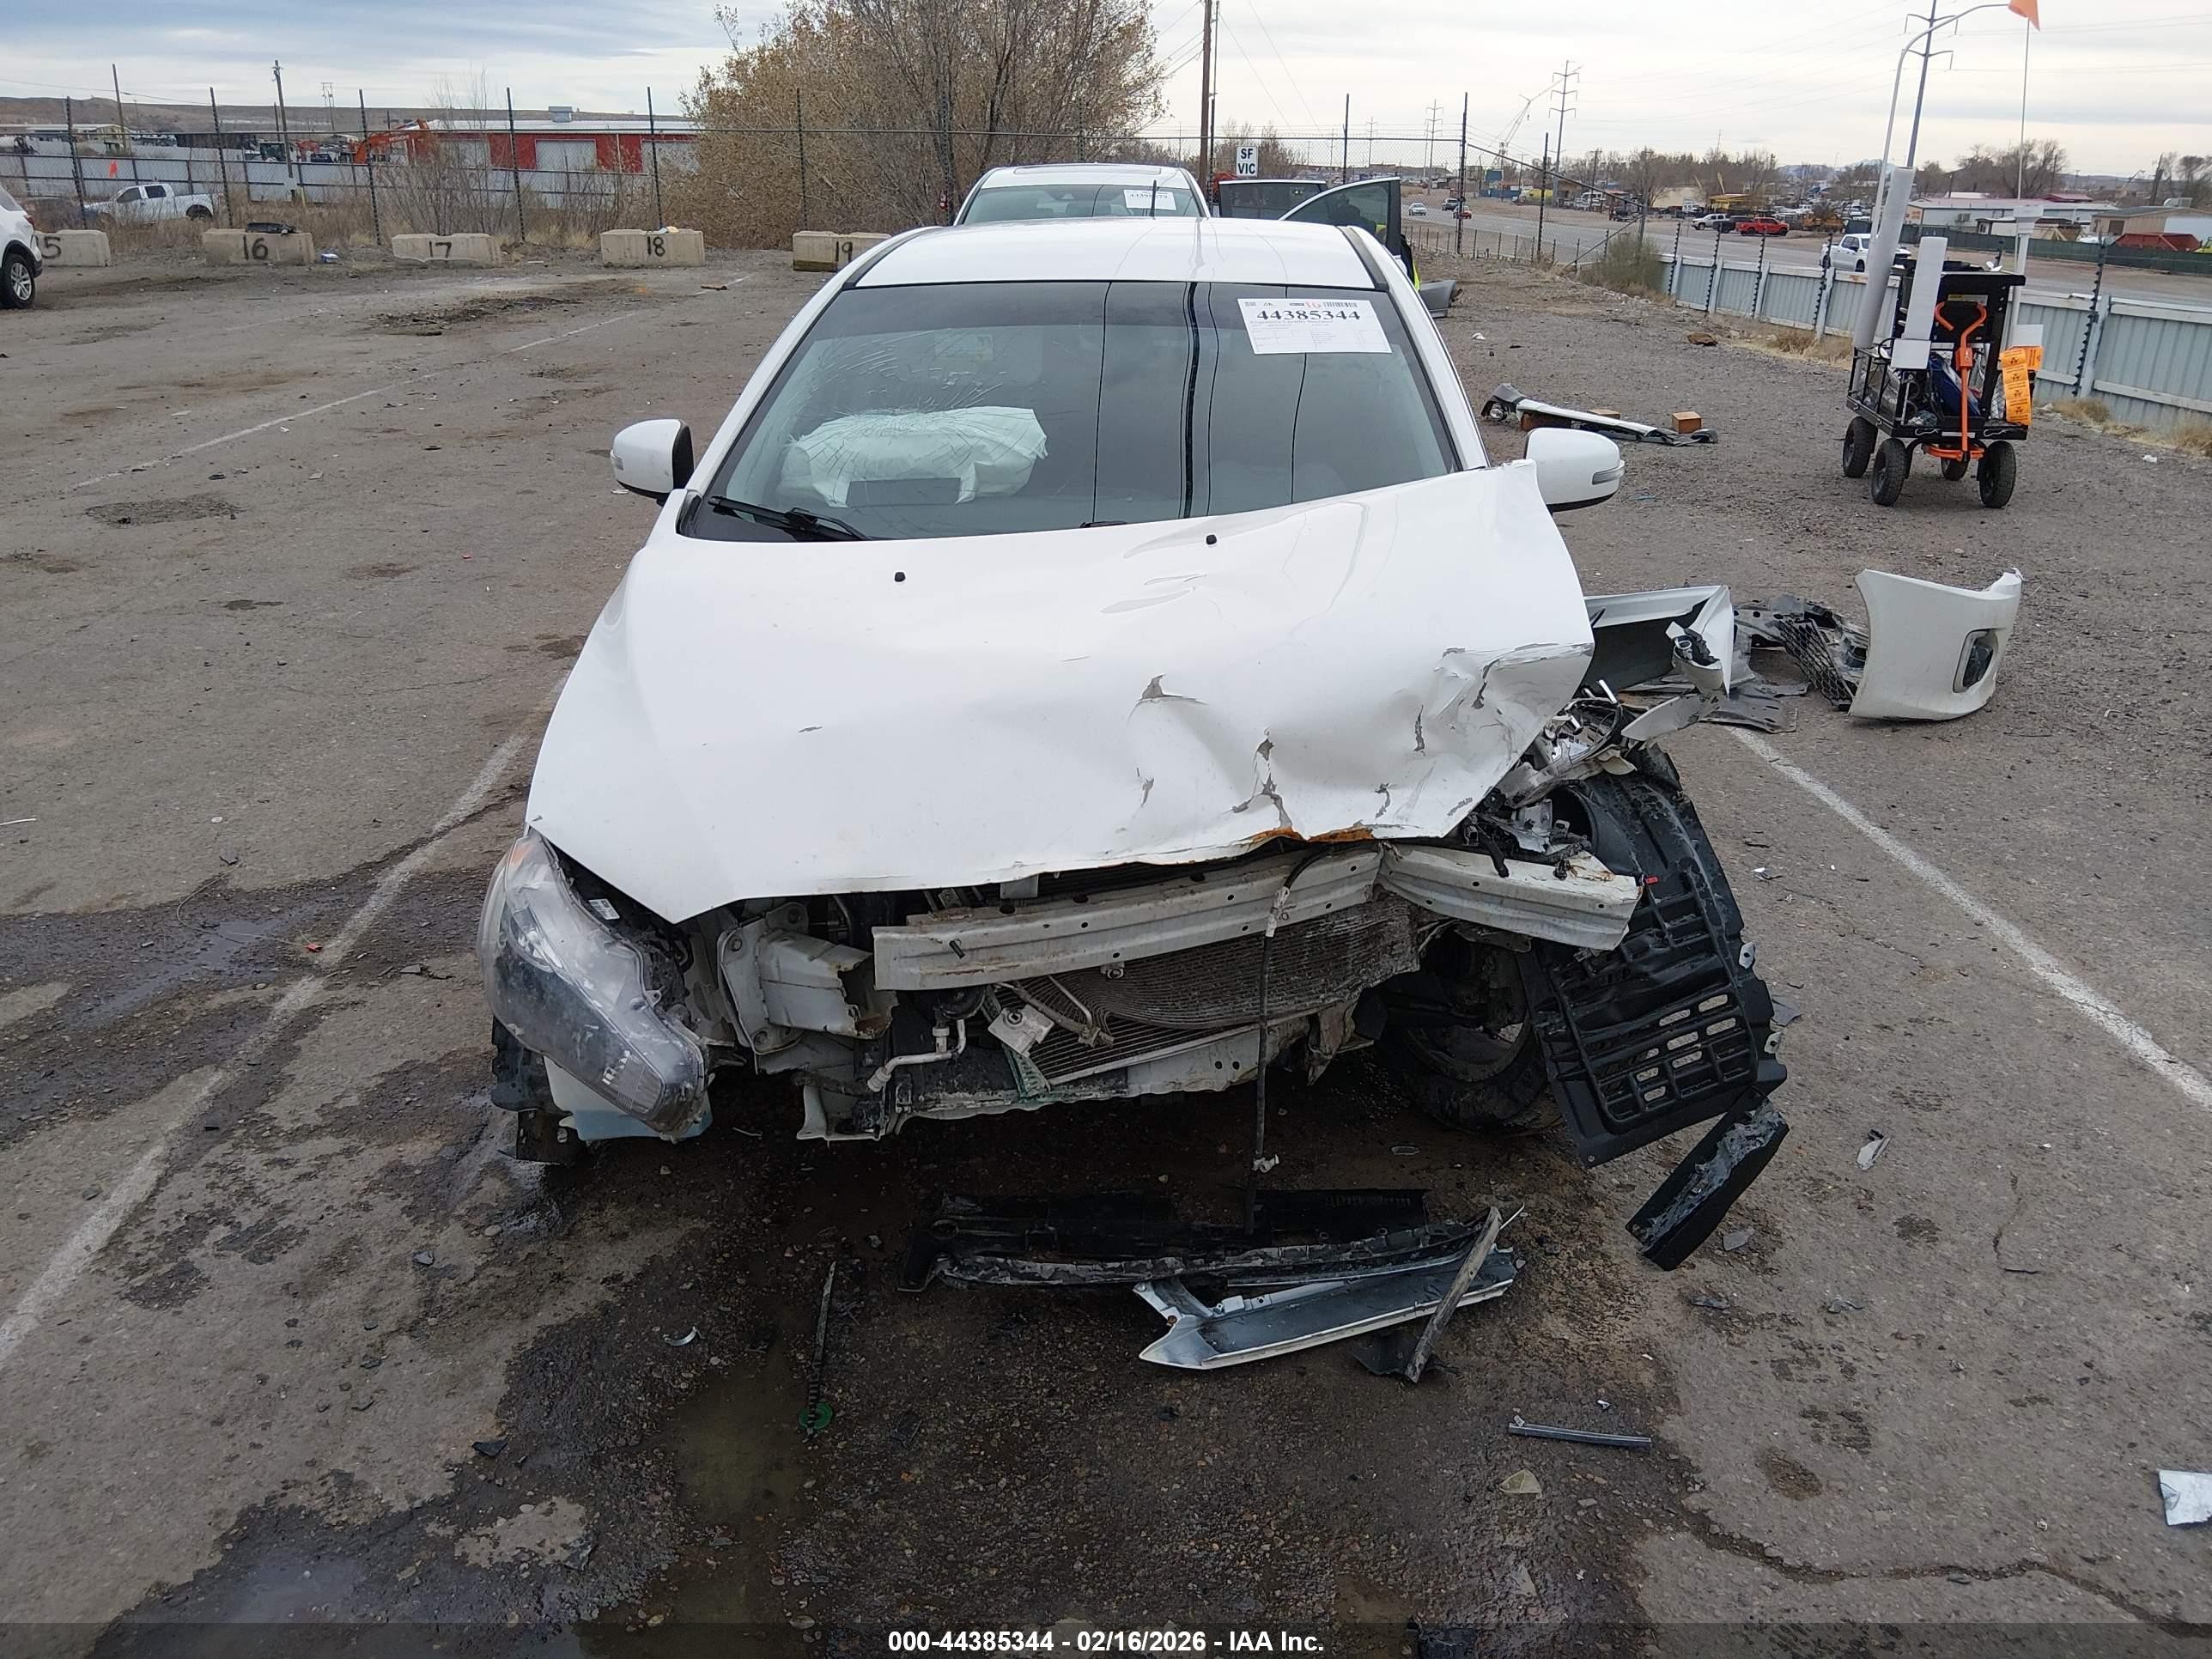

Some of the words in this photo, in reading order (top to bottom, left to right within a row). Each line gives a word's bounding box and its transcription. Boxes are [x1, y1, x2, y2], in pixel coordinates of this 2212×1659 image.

[1240, 148, 1254, 160] SF
[1237, 162, 1255, 174] VIC
[242, 234, 269, 261] 16
[428, 240, 453, 259] 17
[647, 236, 665, 257] 18
[835, 240, 854, 264] 19
[1256, 310, 1361, 320] 44385344
